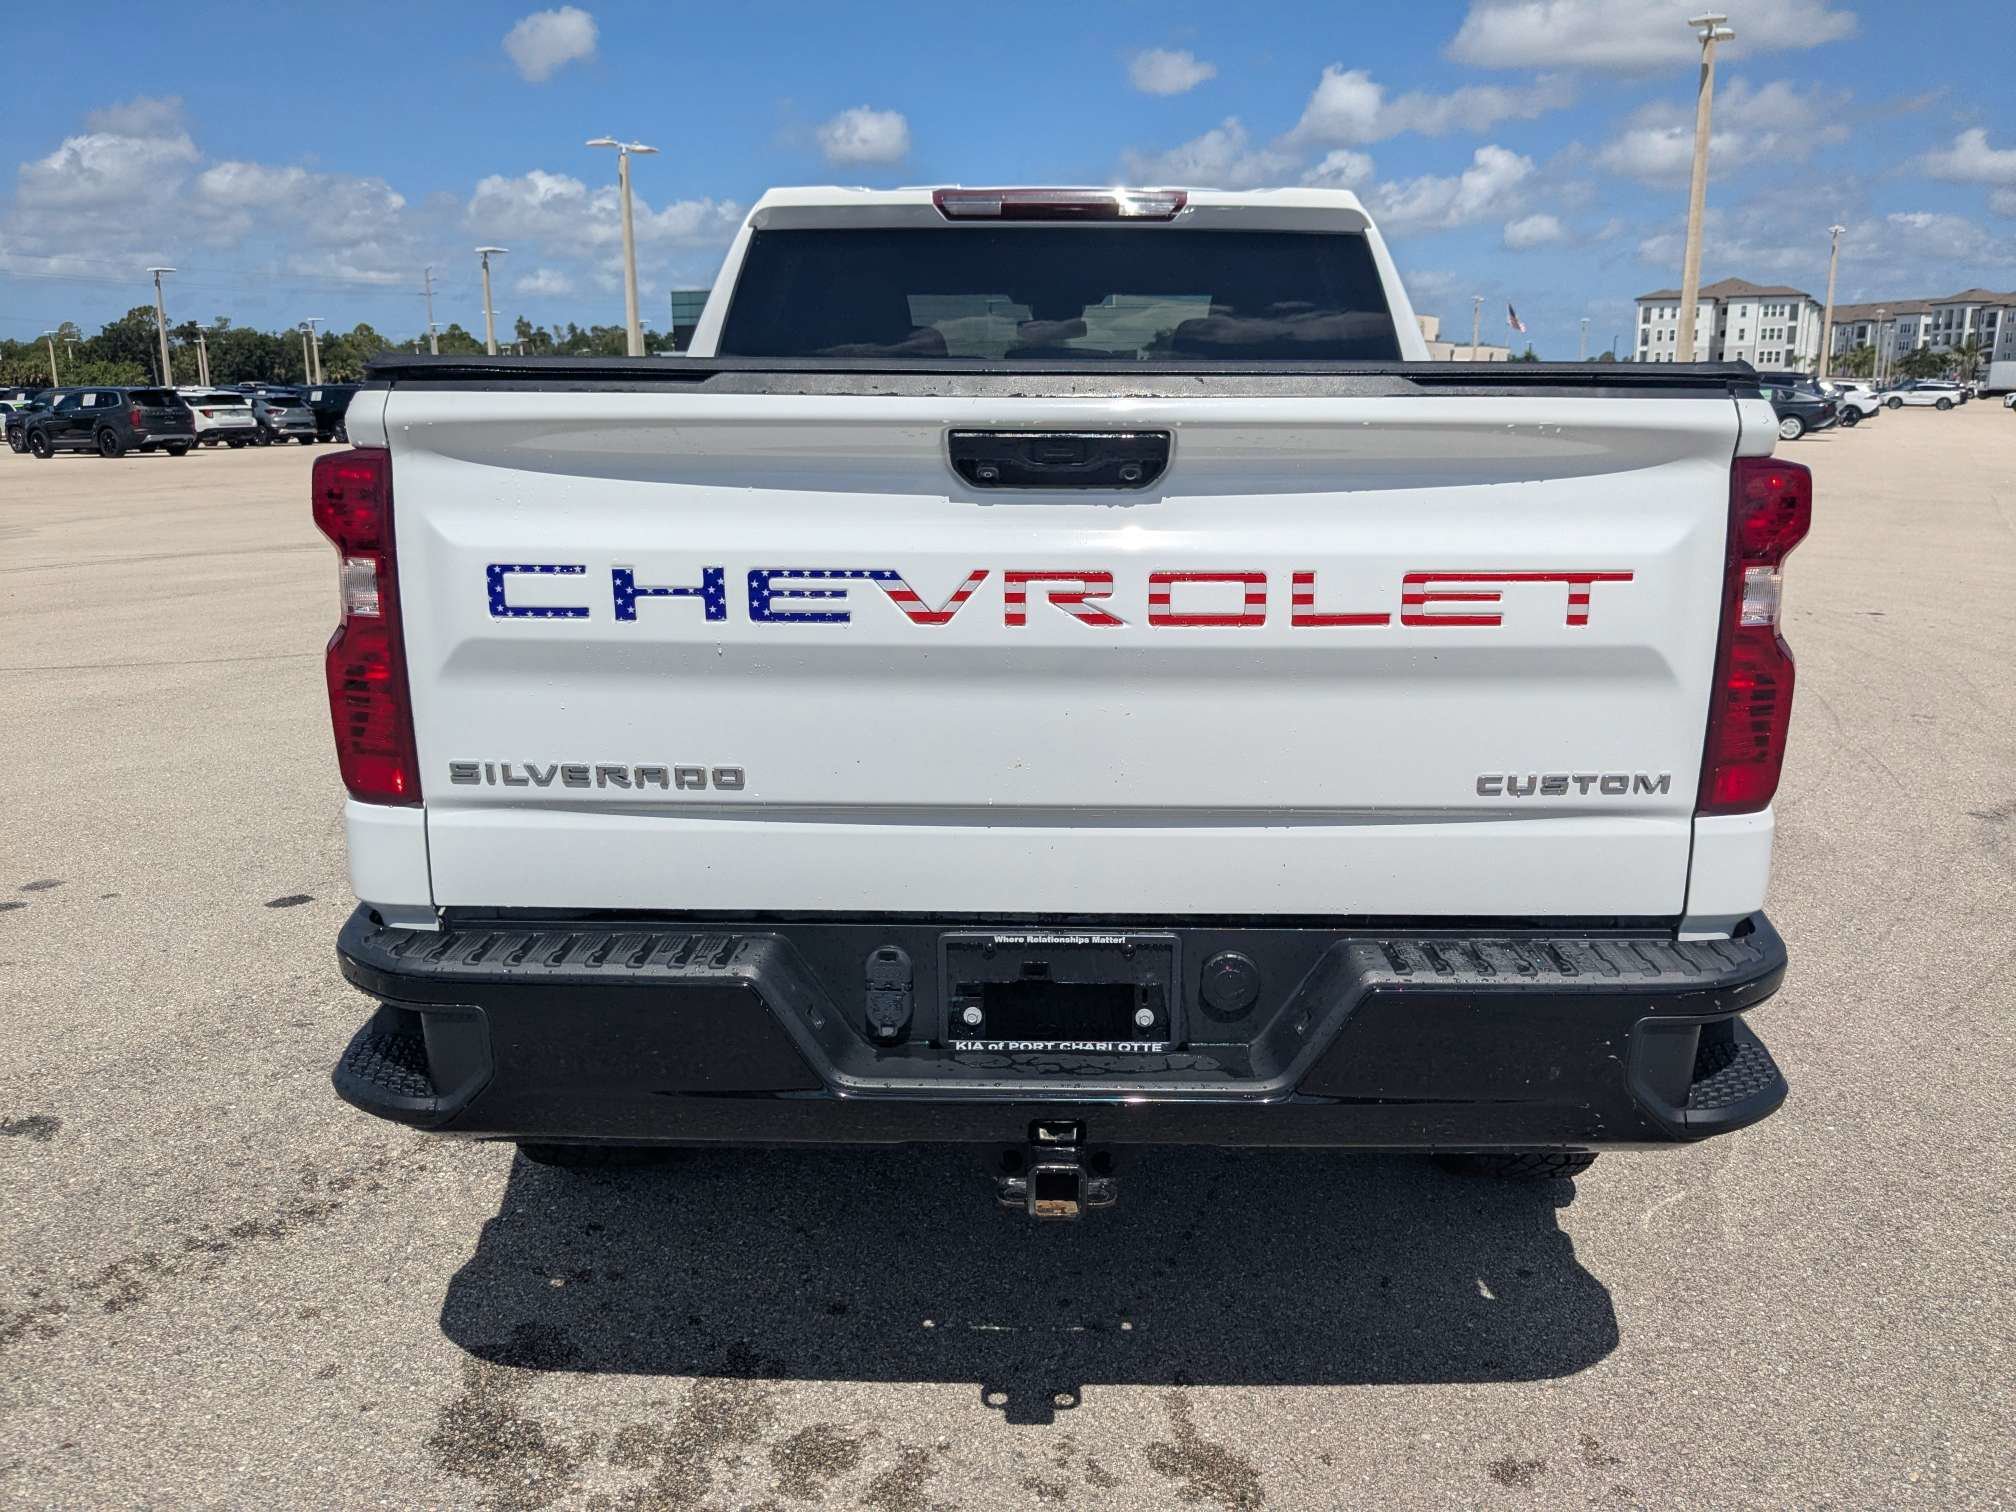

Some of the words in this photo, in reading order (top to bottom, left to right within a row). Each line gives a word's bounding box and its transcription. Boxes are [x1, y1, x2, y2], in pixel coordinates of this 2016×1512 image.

[487, 564, 1634, 628] CHEVROLET
[449, 760, 746, 790] SILVERADO
[1476, 773, 1672, 796] CUSTOM
[994, 936, 1024, 944] Where
[1026, 936, 1089, 944] Relationships
[1092, 936, 1126, 944] Matter!
[955, 1042, 984, 1051] KIA
[988, 1042, 1004, 1050] of
[1008, 1042, 1056, 1050] PORT
